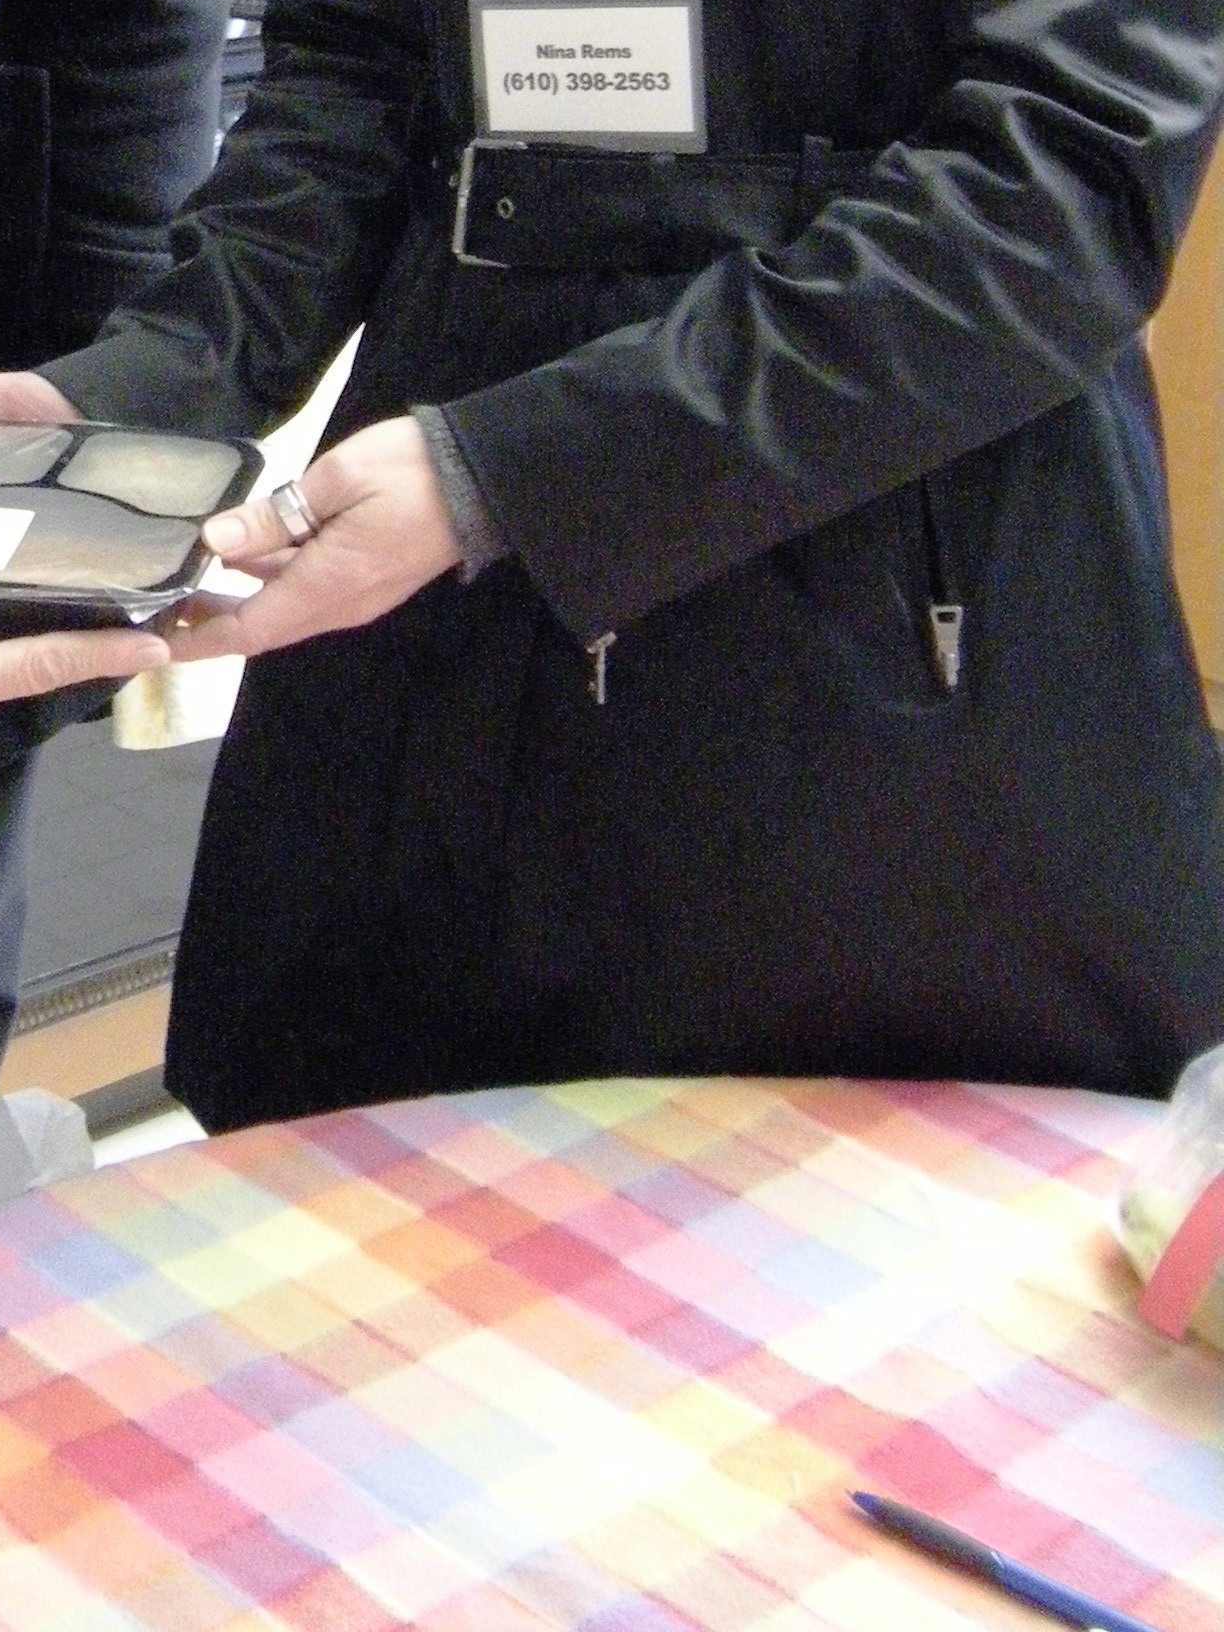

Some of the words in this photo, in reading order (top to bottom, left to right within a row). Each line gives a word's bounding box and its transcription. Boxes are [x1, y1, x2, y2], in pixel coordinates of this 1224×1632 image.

[536, 44, 576, 59] Nina
[581, 44, 632, 59] Rems
[503, 72, 559, 95] (610)
[566, 71, 671, 92] 398-2563
